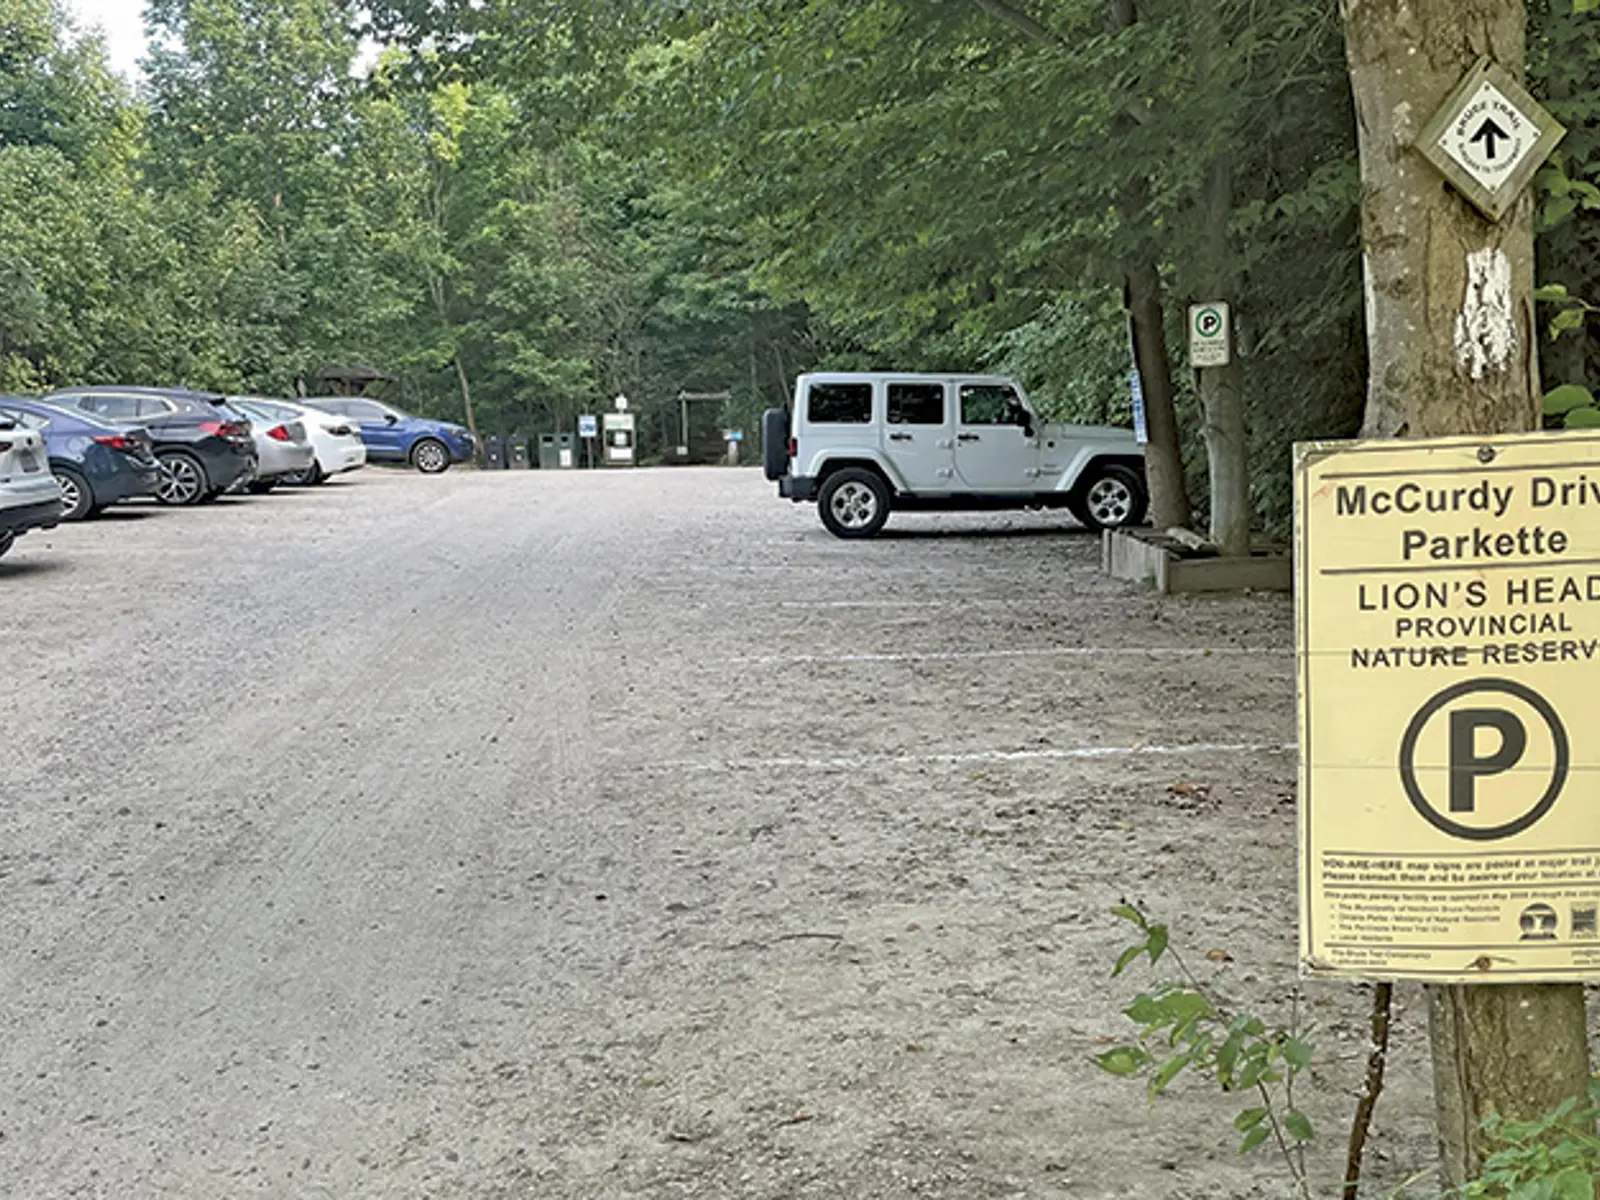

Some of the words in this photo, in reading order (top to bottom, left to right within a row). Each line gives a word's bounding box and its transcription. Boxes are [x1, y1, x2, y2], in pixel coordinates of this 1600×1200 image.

[1492, 101, 1521, 130] TRAIL
[1203, 315, 1217, 330] P
[1336, 480, 1513, 517] McCurdy
[1402, 527, 1568, 560] Parkette
[1359, 580, 1487, 611] LION'S
[1507, 574, 1600, 605] HEAD
[1396, 612, 1572, 638] PROVINCIAL
[1351, 647, 1468, 668] NATURE
[1449, 708, 1527, 813] P
